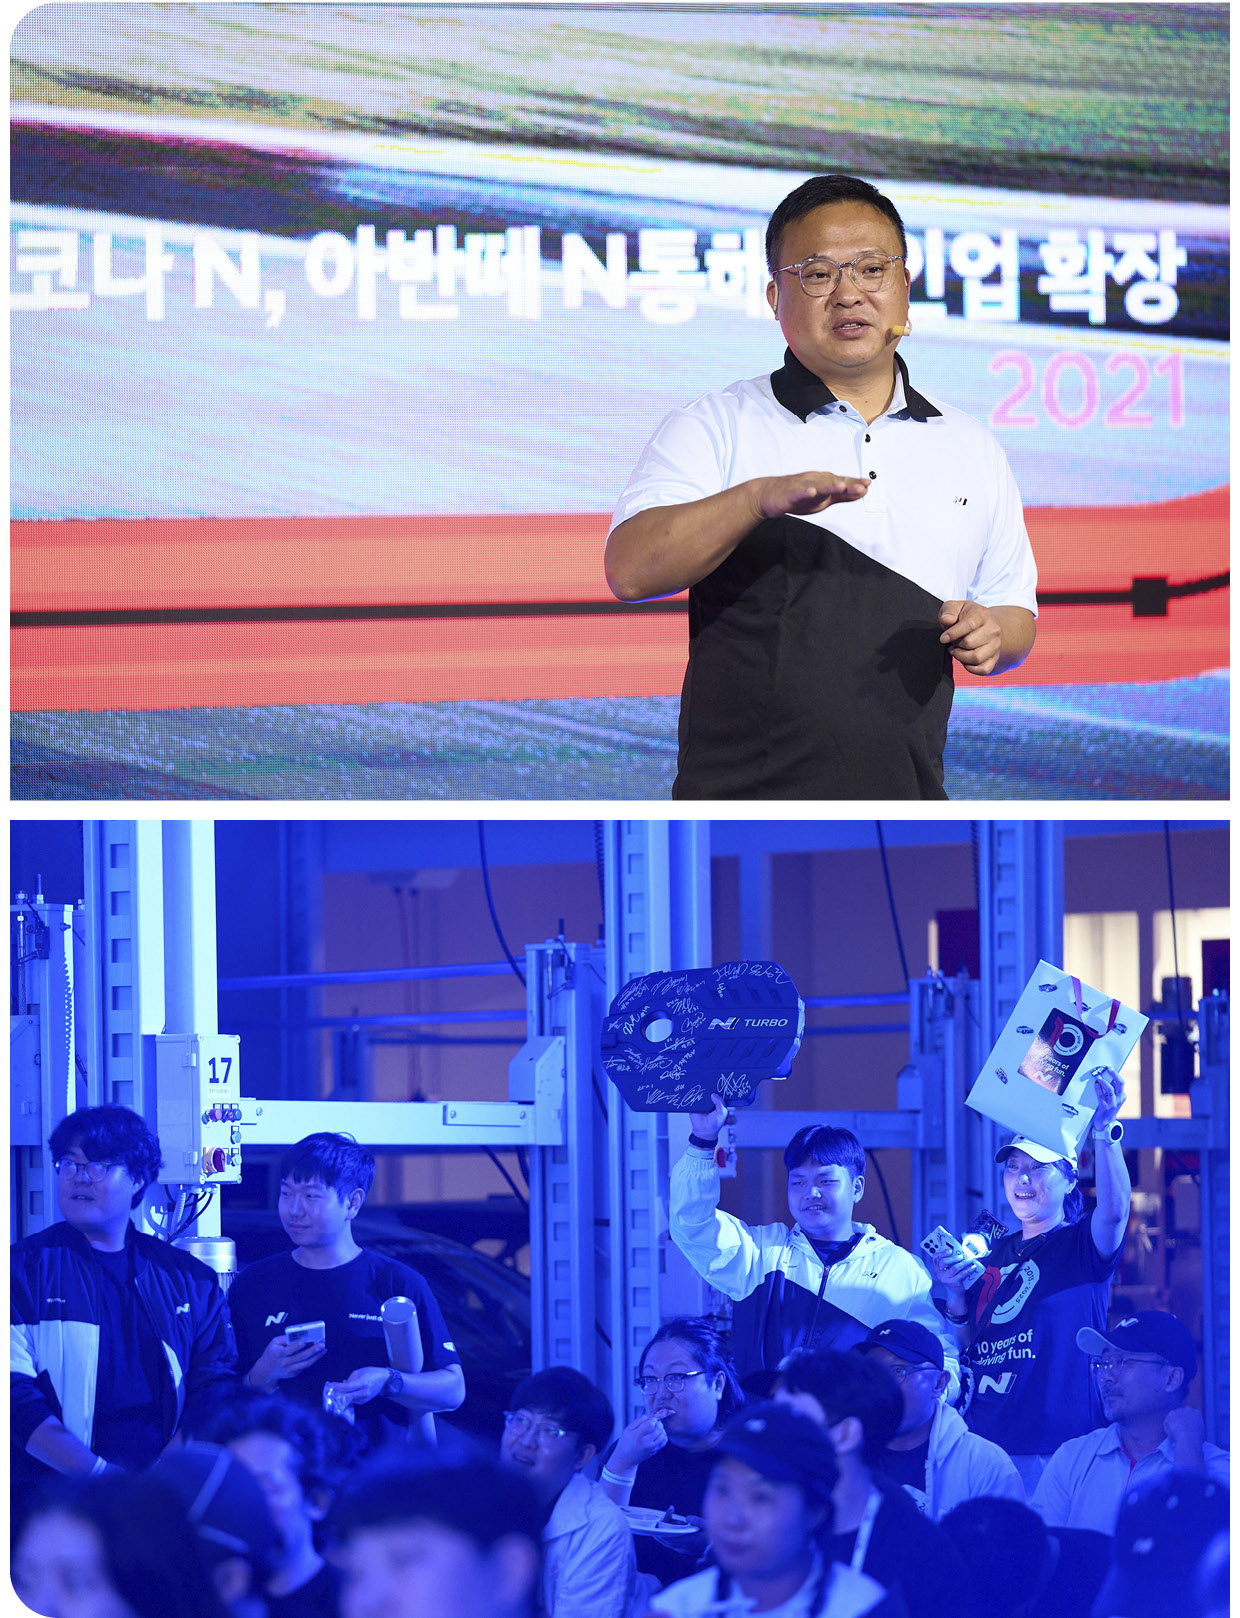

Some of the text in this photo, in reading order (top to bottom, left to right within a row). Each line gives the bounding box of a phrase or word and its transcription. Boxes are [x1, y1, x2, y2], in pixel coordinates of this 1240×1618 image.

[10, 225, 174, 321] 코나
[304, 225, 541, 320] 아반떼
[907, 228, 1020, 323] 인업
[1038, 228, 1188, 326] 확장
[989, 351, 1184, 428] 2021
[744, 1018, 788, 1027] TURBO
[208, 1057, 232, 1084] 17
[976, 1329, 1033, 1355] 10 years of
[1008, 1347, 1036, 1359] fun.
